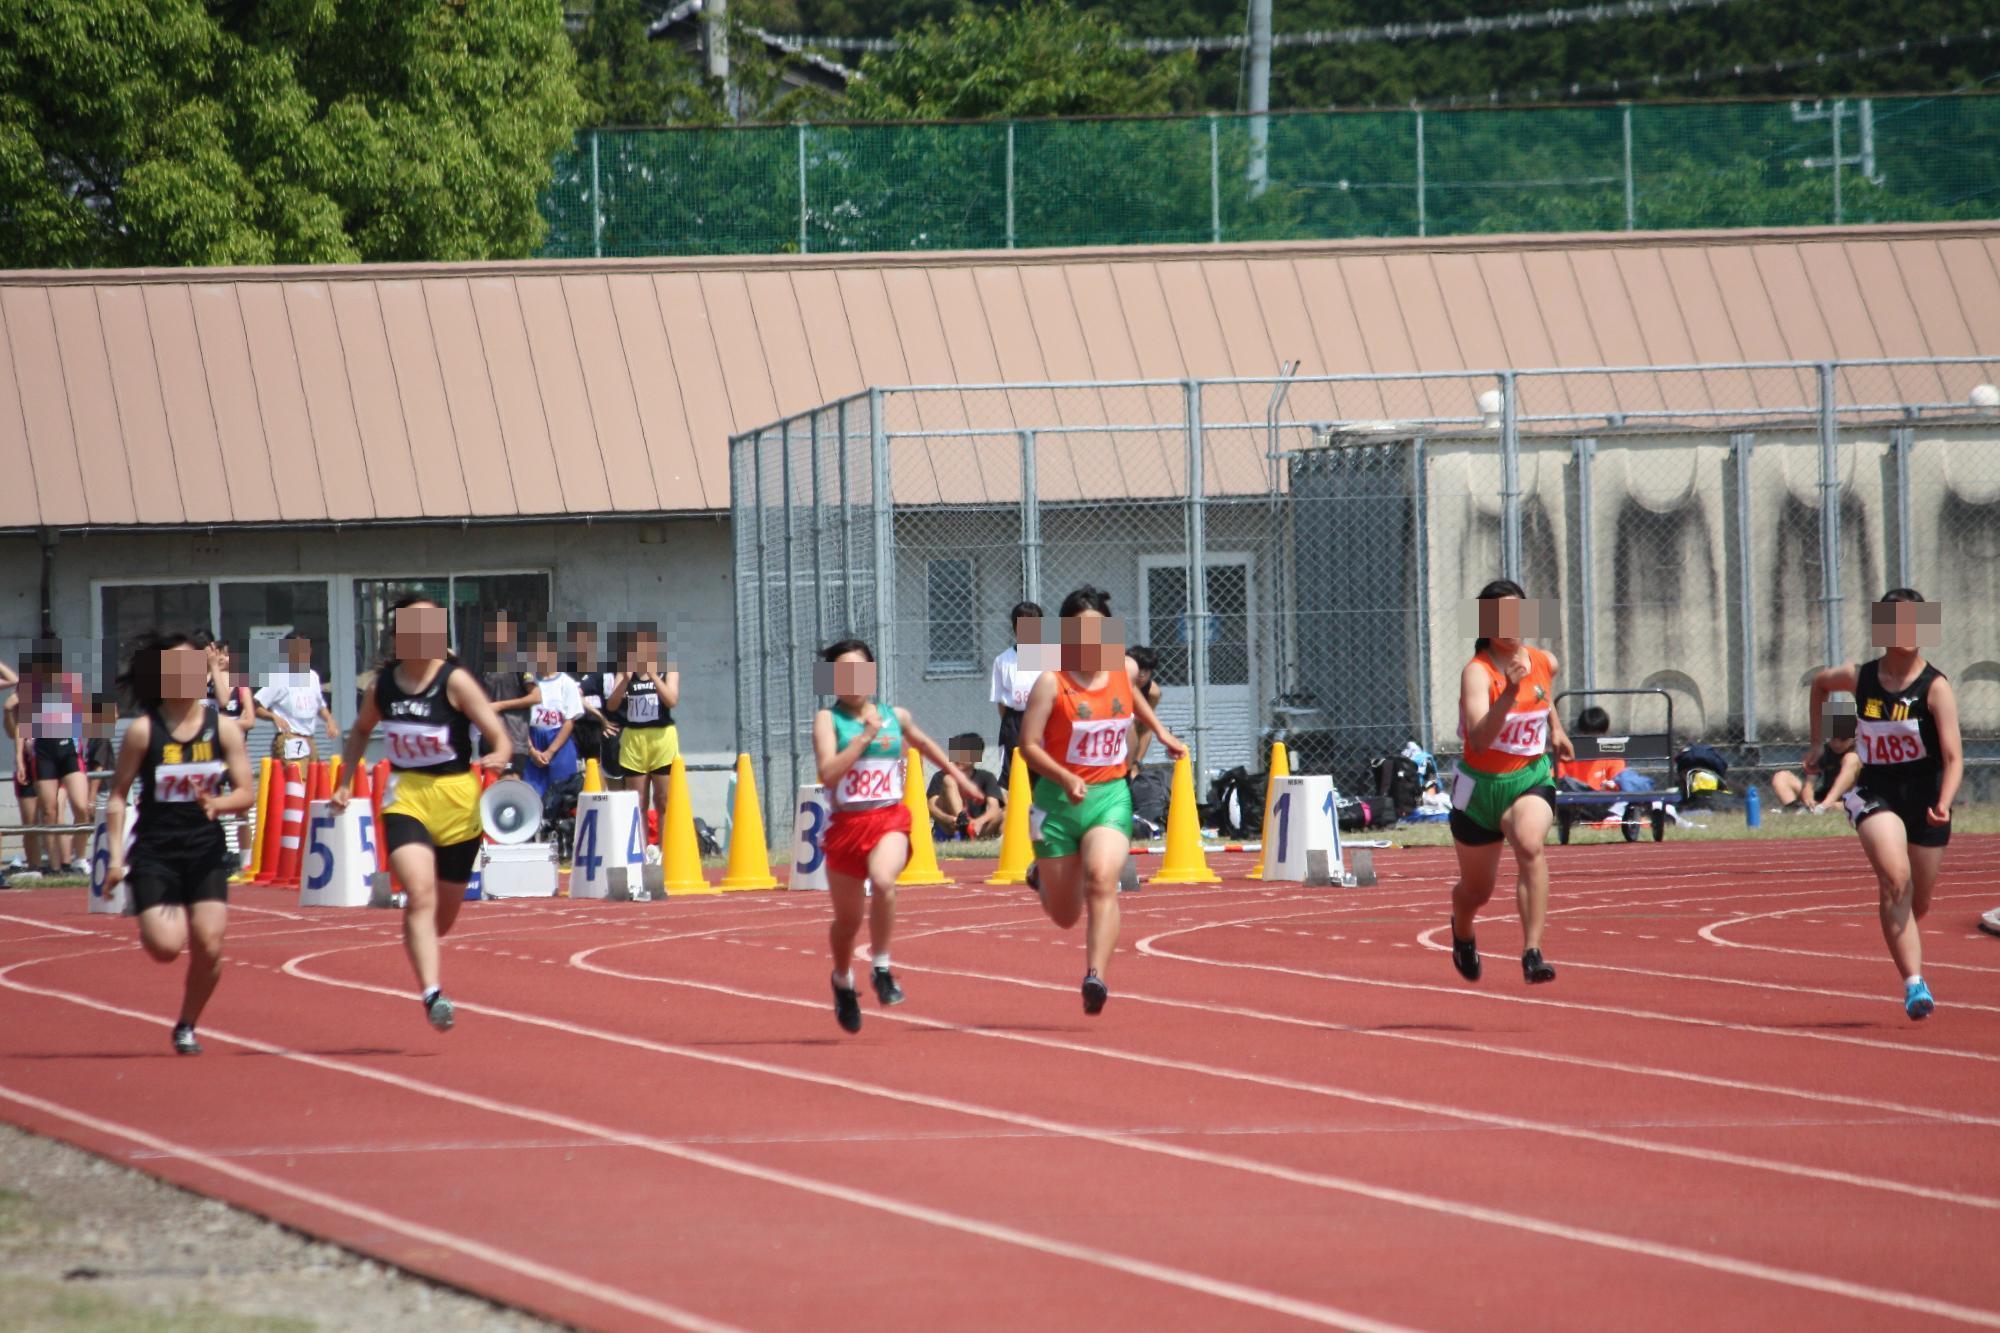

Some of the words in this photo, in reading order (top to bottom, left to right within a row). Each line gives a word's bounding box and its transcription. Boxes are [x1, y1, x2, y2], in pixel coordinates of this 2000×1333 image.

[92, 822, 110, 897] 6
[307, 817, 335, 889] 5
[575, 809, 603, 882] 4
[626, 806, 645, 864] 4
[797, 801, 825, 874] 3
[1273, 792, 1290, 863] 1
[1322, 791, 1340, 861] 1
